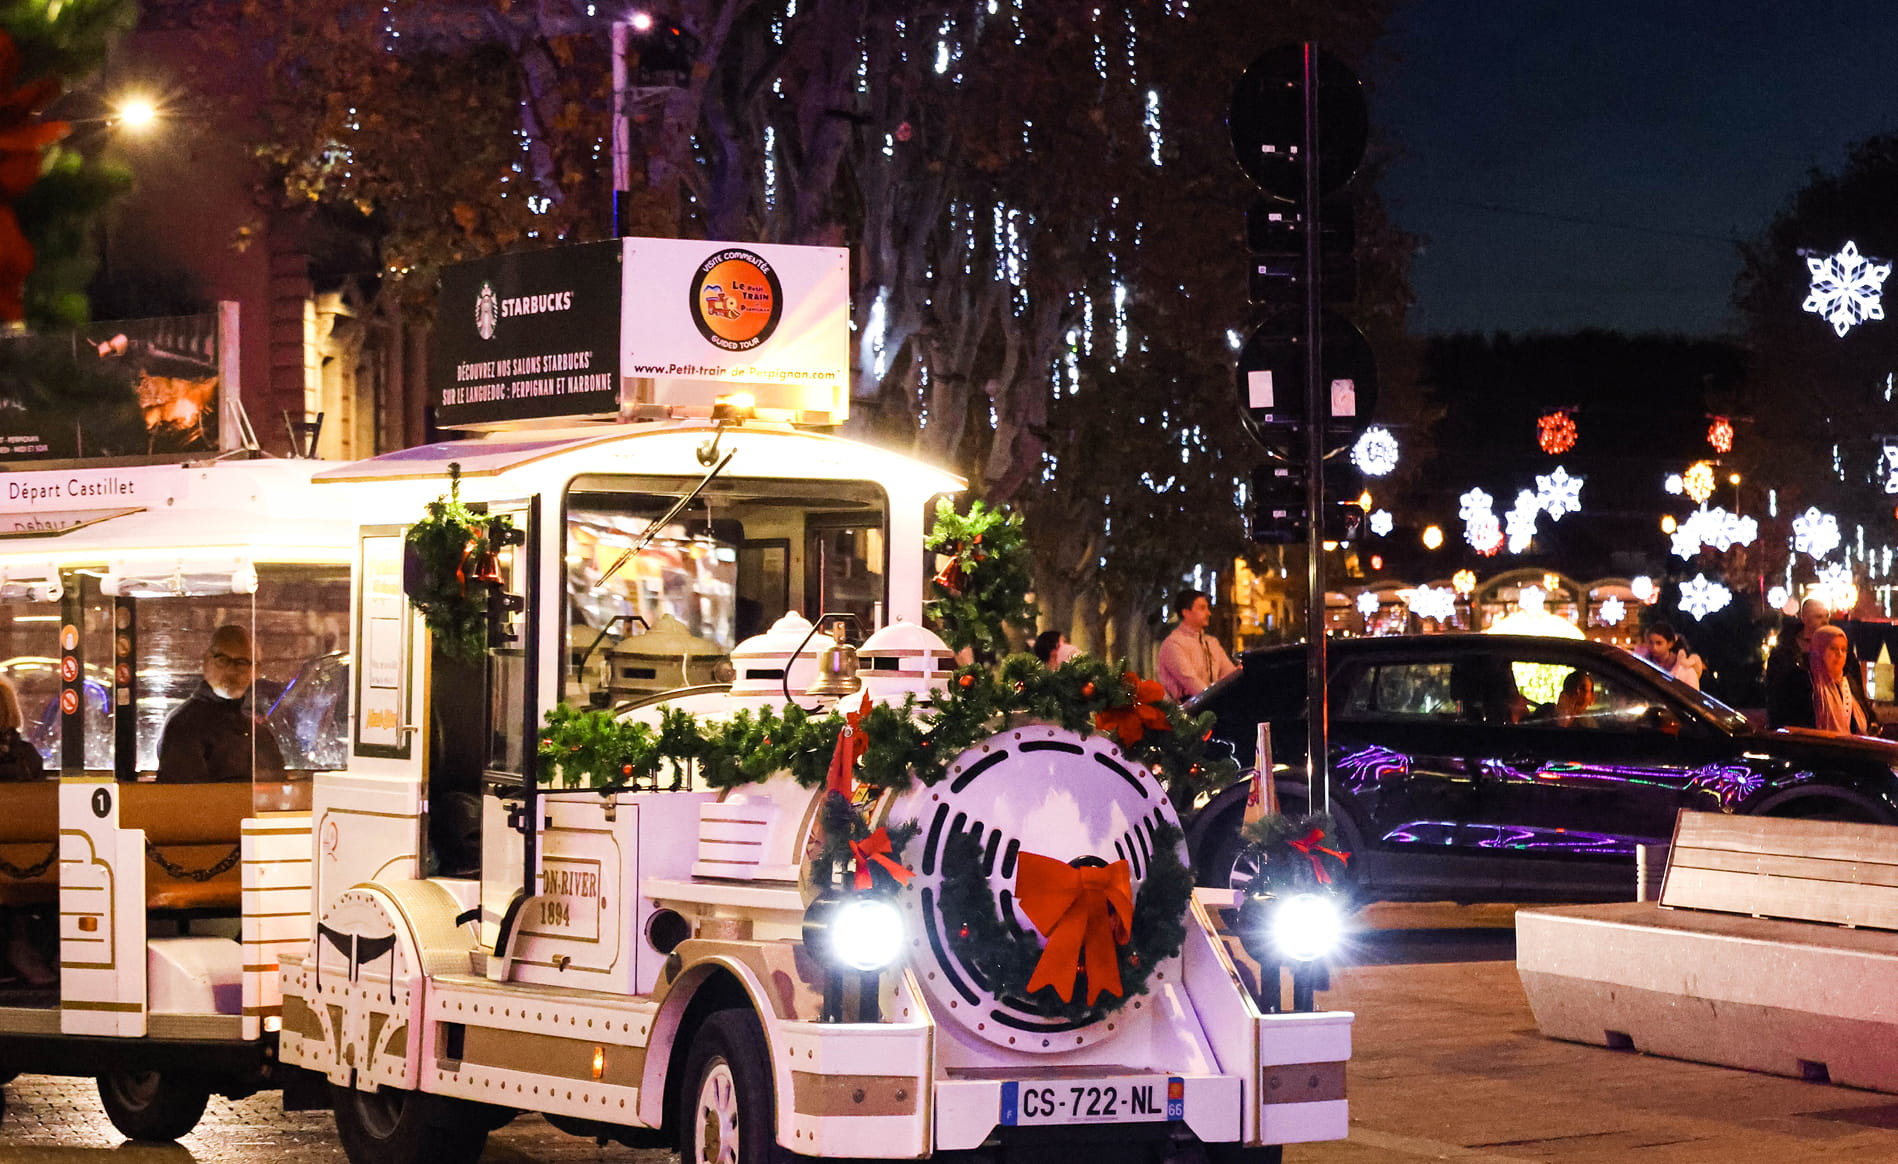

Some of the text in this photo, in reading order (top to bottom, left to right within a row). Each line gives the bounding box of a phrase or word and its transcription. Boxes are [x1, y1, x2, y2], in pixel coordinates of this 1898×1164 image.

[703, 252, 770, 274] VISITE COMMENTÉE
[732, 281, 745, 290] Le
[742, 292, 769, 300] TRAIN
[501, 291, 572, 317] STARBUCKS
[711, 335, 760, 349] GUIDED TOUR
[457, 352, 590, 381] DÉCOUVREZ NOS SALONS STARBUCKS
[442, 388, 456, 405] SUR
[457, 387, 465, 404] LE
[466, 383, 505, 403] LANGUEDOC
[511, 378, 554, 398] PERPIGNAN
[556, 377, 565, 394] ET
[568, 373, 612, 393] NARBONNE
[9, 477, 134, 504] Départ Castillet
[540, 901, 570, 927] 1894
[1023, 1085, 1162, 1117] CS-722-NL
[1167, 1103, 1183, 1117] 66
